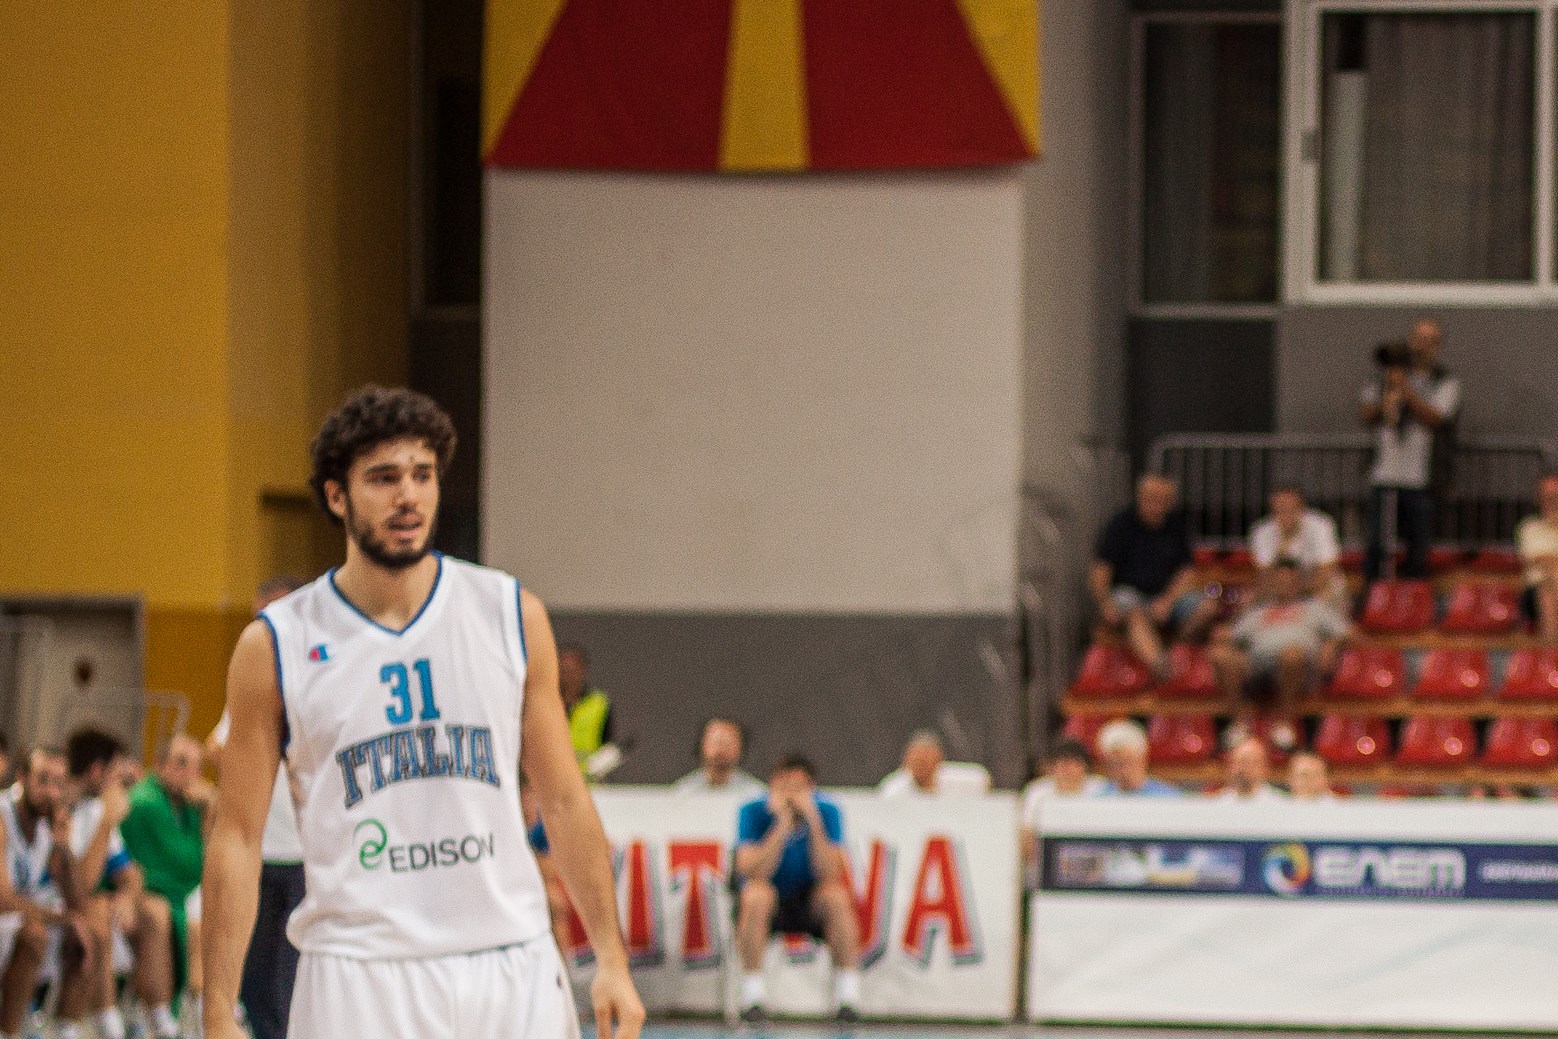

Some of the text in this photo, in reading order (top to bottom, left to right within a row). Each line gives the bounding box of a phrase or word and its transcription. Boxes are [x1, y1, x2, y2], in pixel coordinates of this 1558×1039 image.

[379, 657, 441, 725] 31
[335, 724, 500, 809] ITALIA
[388, 832, 495, 873] EDISON
